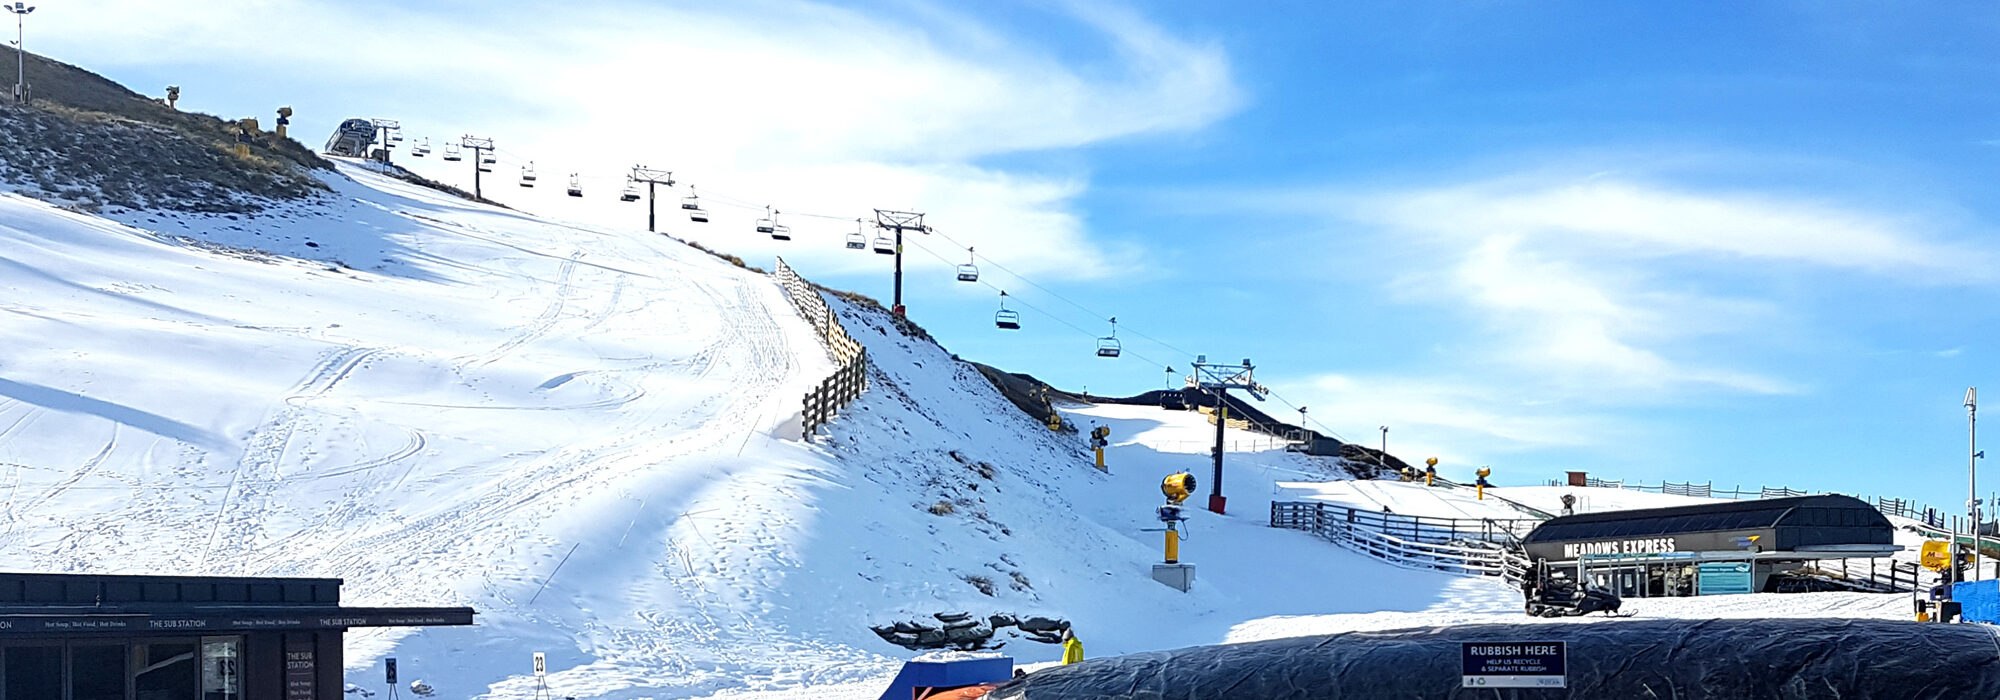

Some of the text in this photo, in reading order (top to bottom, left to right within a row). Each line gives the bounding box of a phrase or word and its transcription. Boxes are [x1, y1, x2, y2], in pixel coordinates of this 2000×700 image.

[1564, 538, 1675, 558] MEADOWS EXPRESS
[150, 620, 206, 628] THE SUB STATION
[343, 618, 367, 626] STATION
[1470, 645, 1557, 656] RUBBISH HERE
[287, 652, 313, 660] THE SUB
[287, 661, 314, 669] STATION
[535, 656, 544, 672] 23
